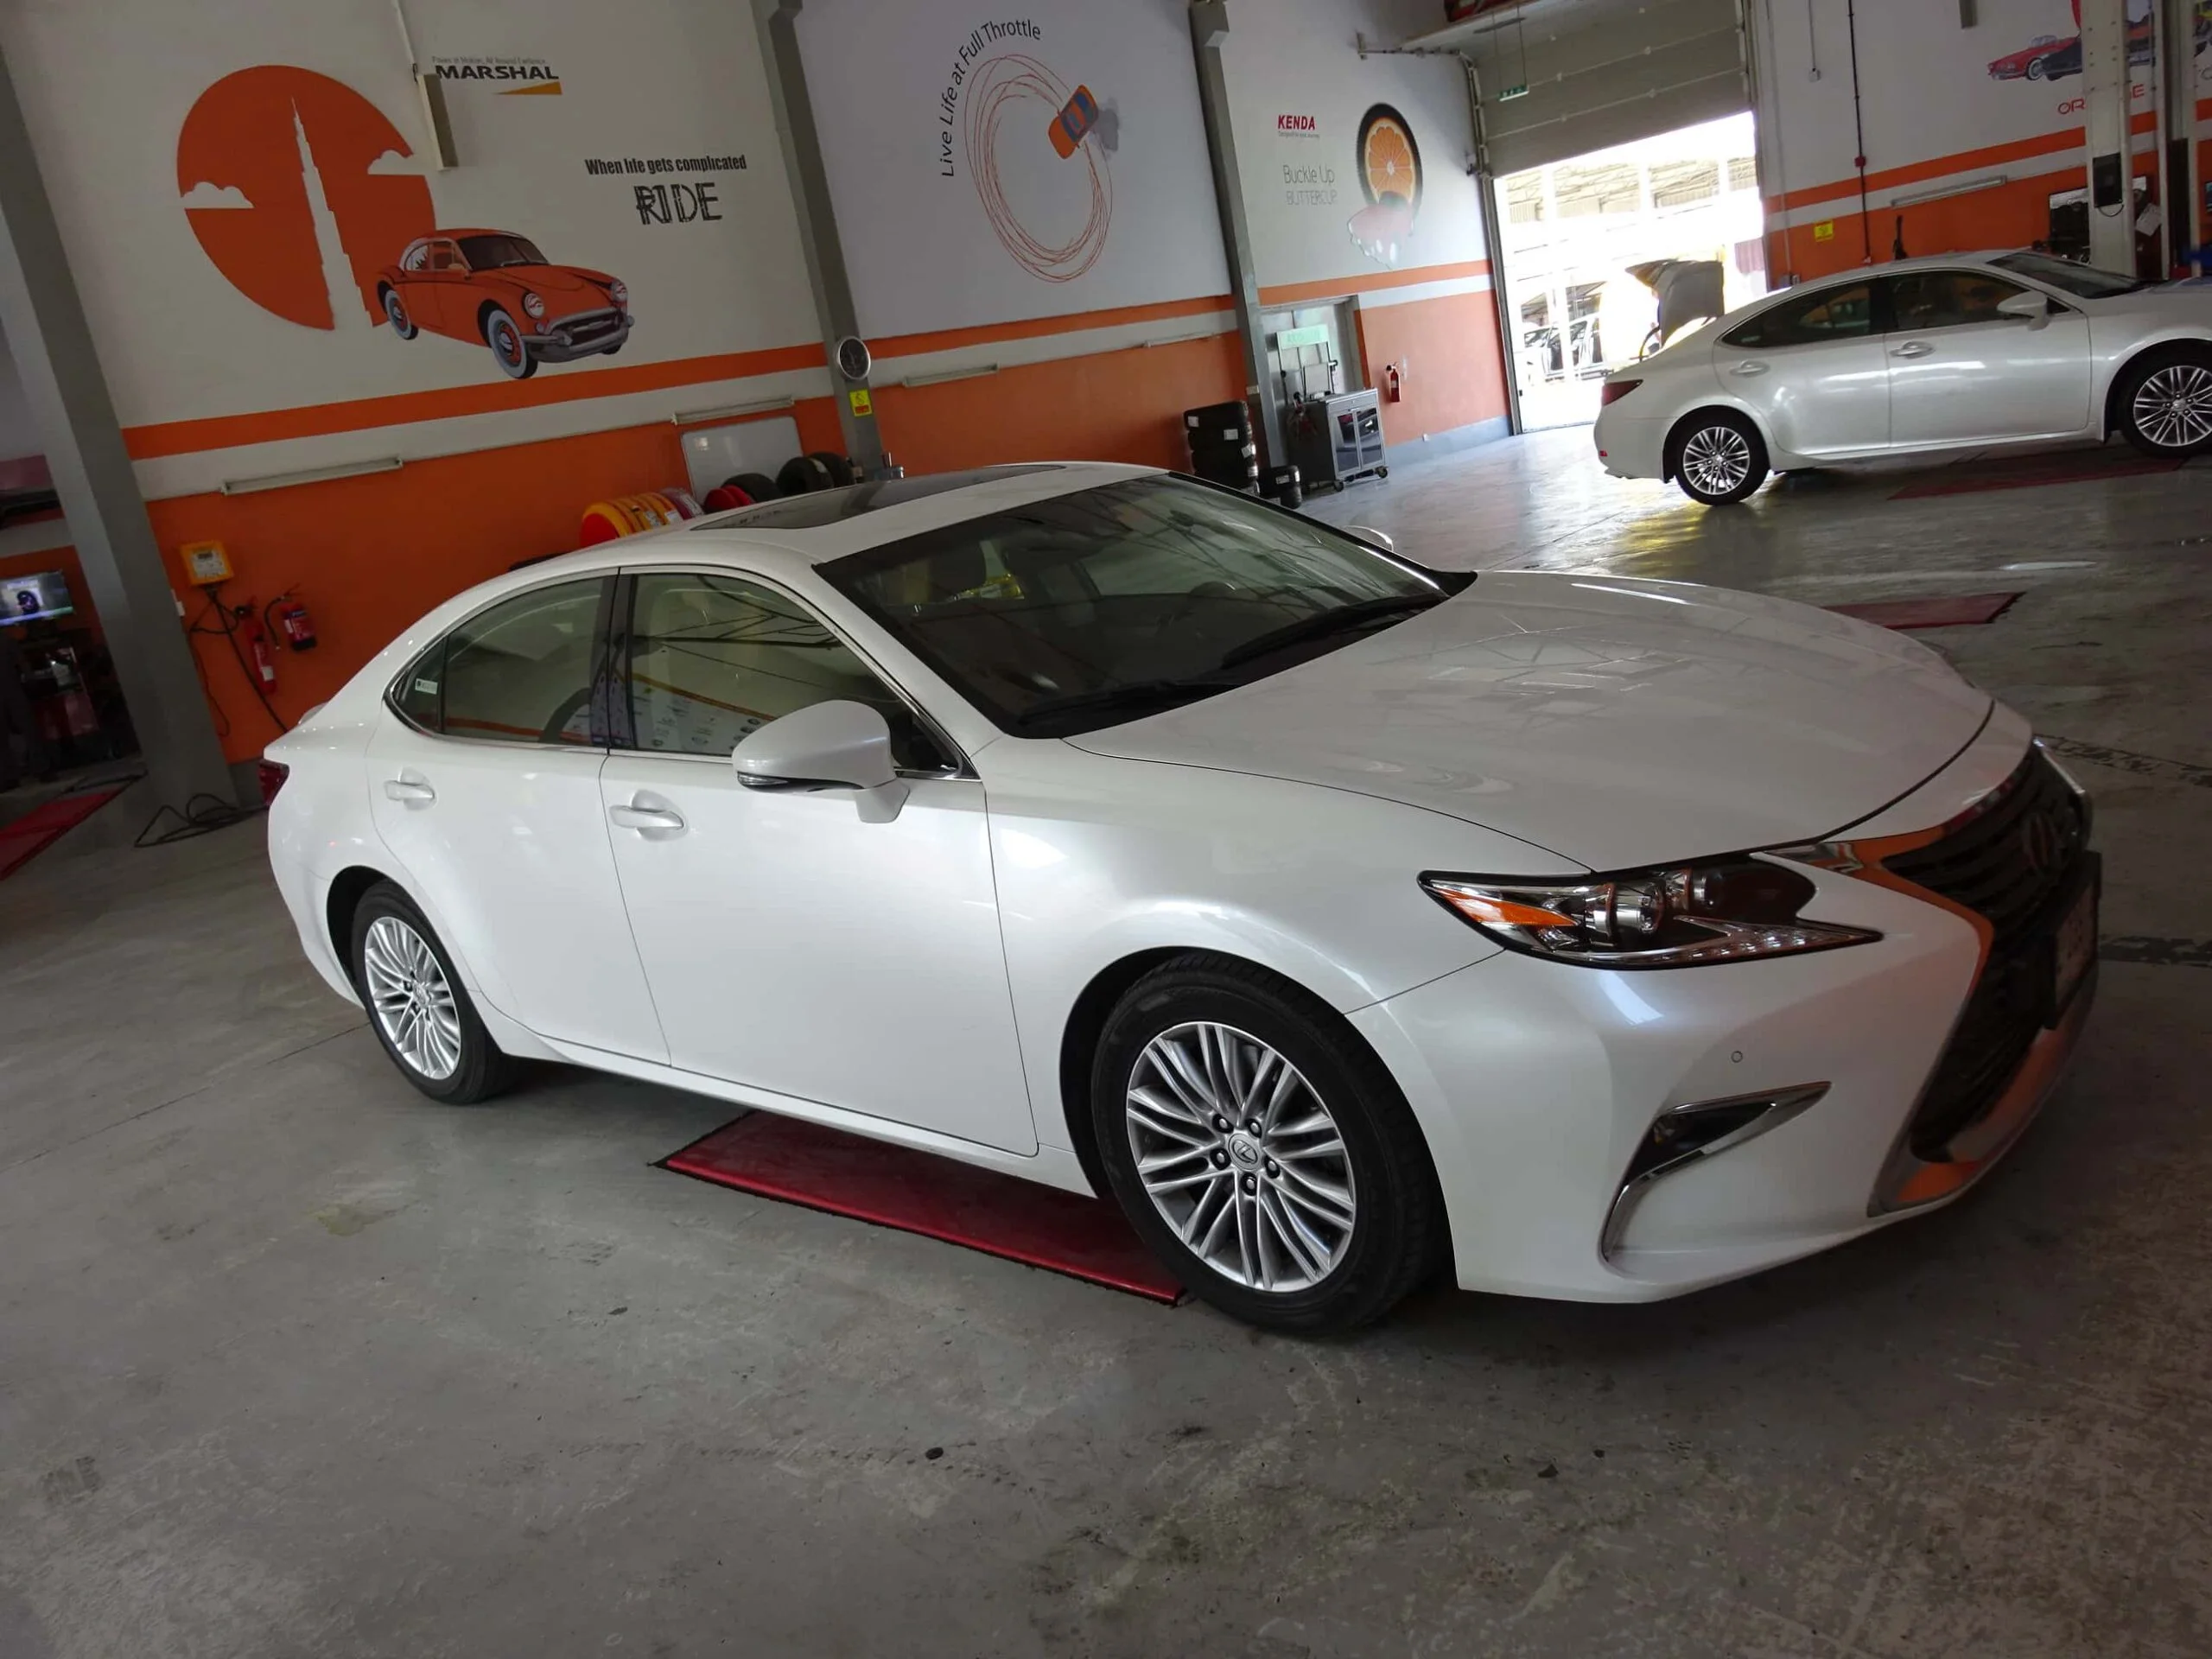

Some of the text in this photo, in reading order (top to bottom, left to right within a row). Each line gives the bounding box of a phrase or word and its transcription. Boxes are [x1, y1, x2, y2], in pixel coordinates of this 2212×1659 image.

[435, 65, 560, 79] MARSHAL
[939, 19, 1041, 177] Live Life at Full Throttle
[1277, 114, 1316, 130] KENDA
[584, 154, 747, 175] When life gets complicated
[1282, 163, 1336, 187] Buckle Up
[633, 181, 723, 226] RIDE
[1286, 188, 1338, 206] BUTTERCUP
